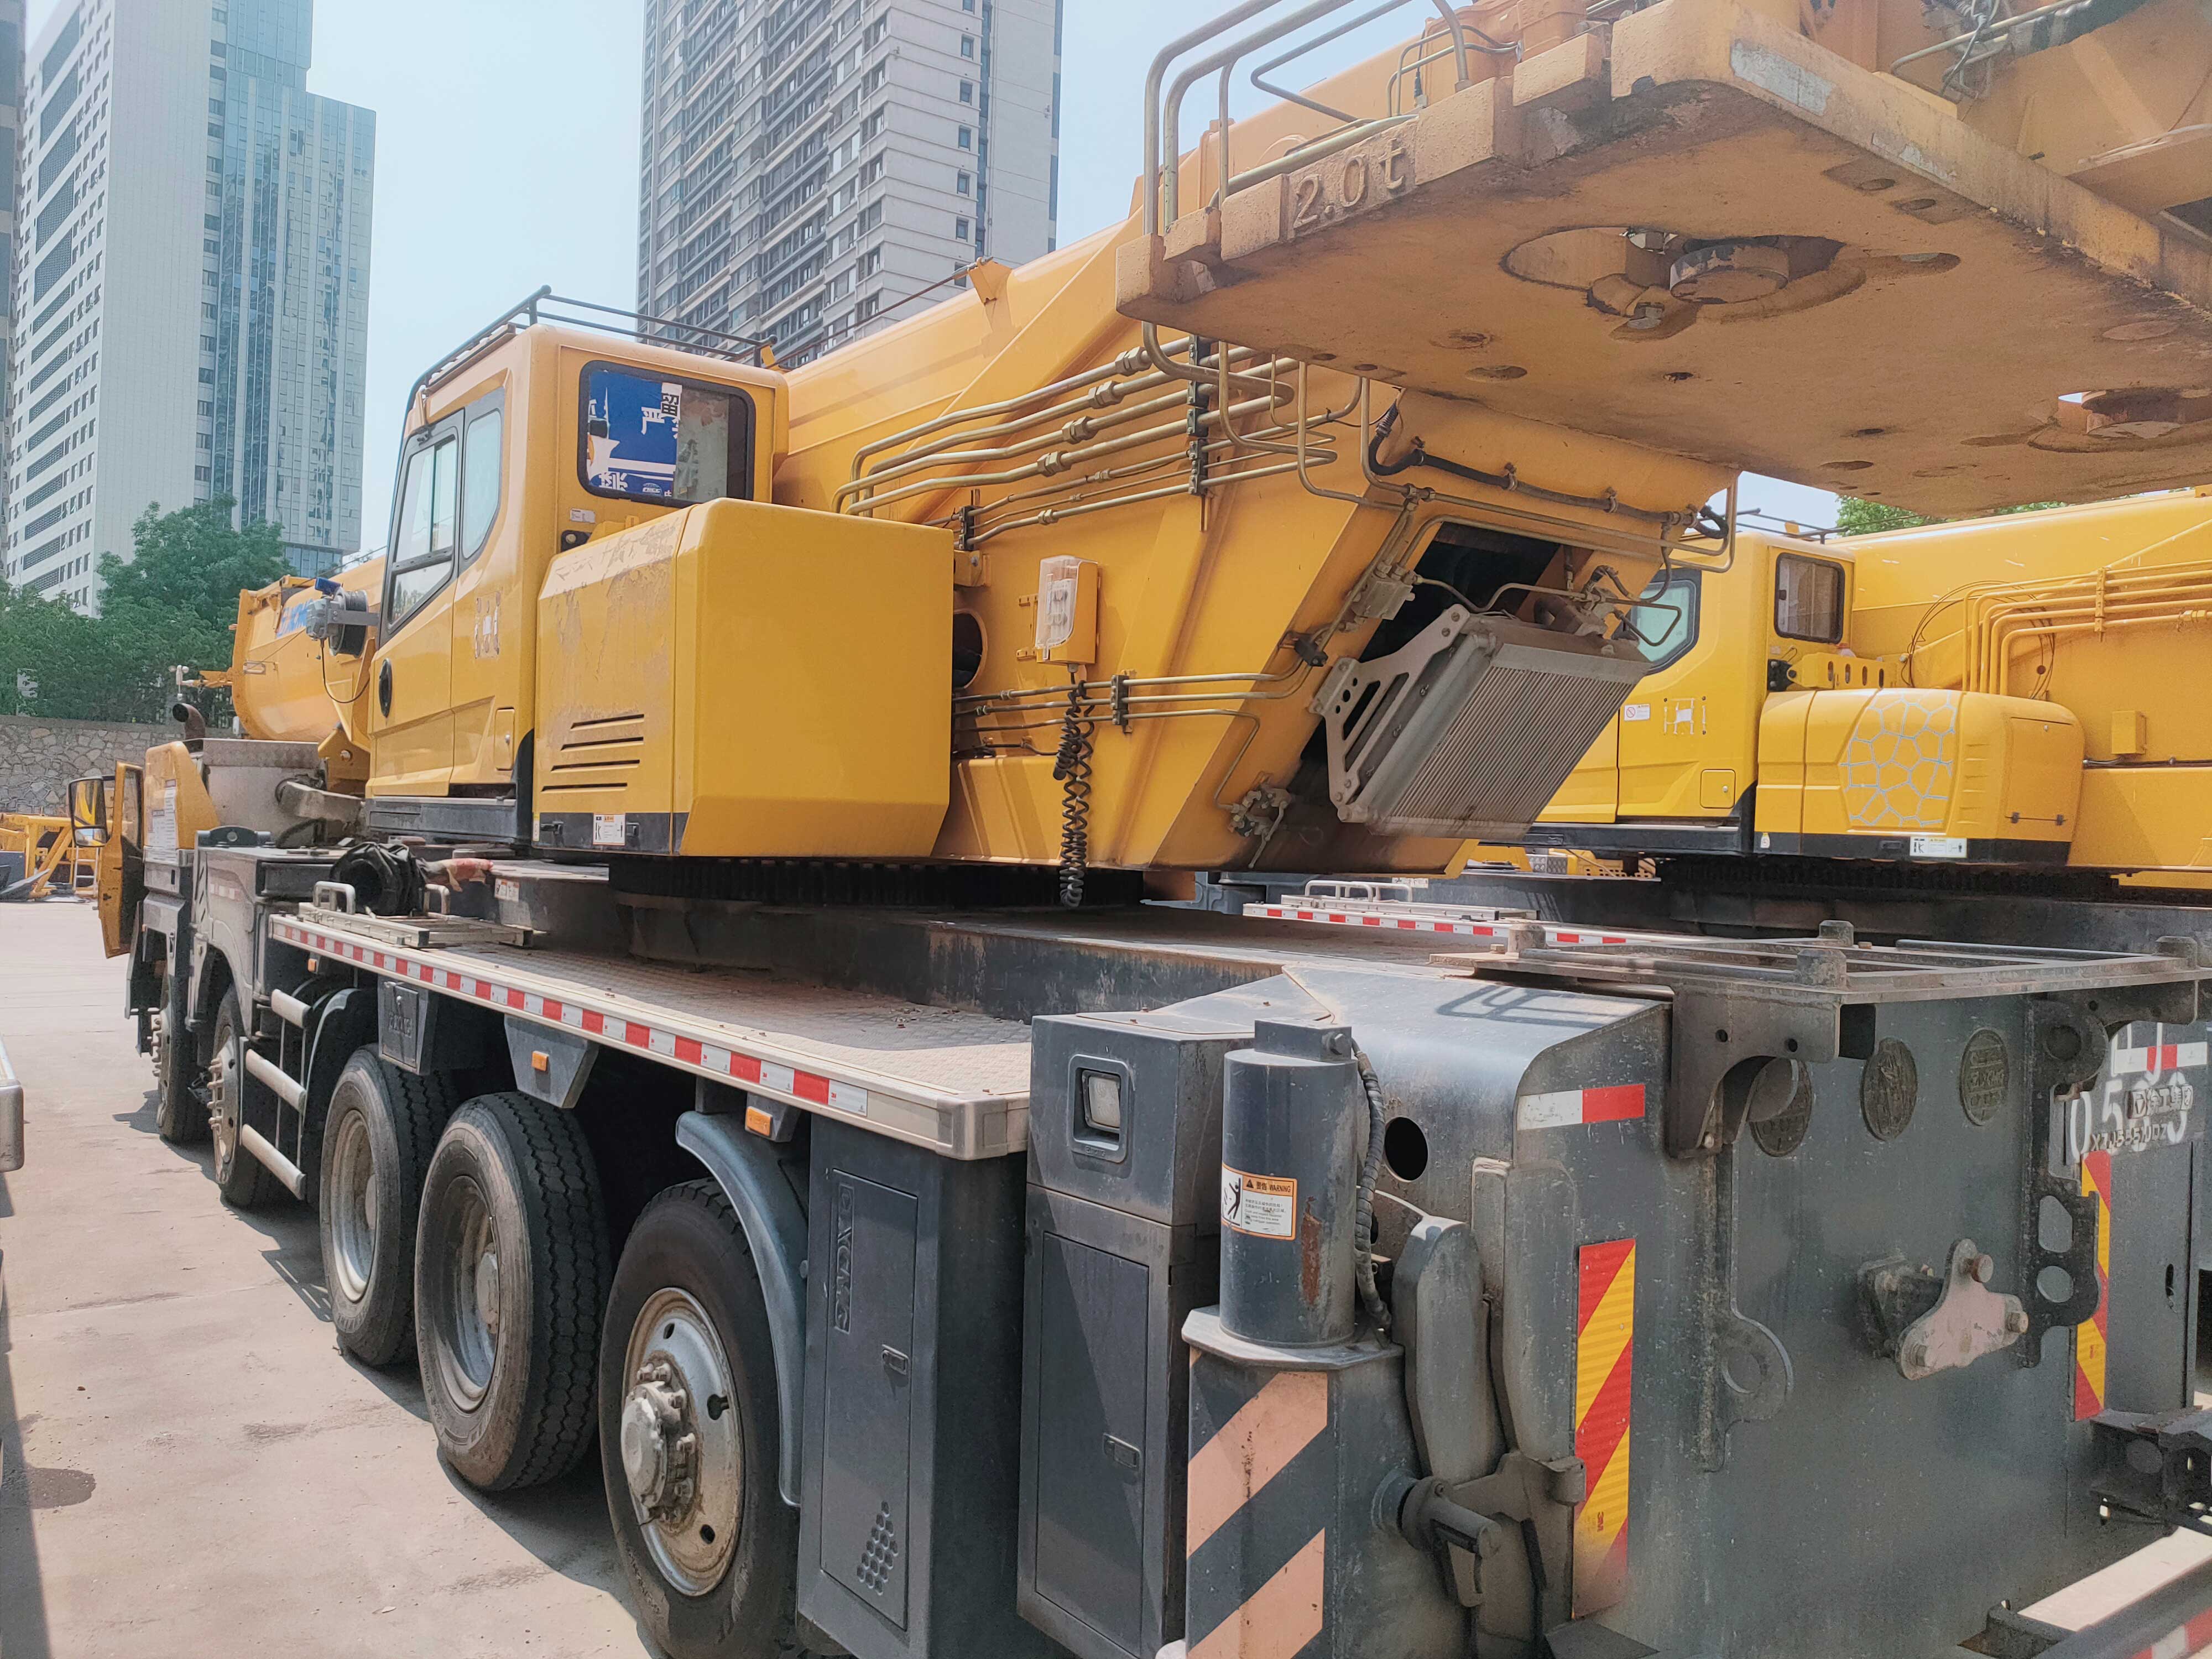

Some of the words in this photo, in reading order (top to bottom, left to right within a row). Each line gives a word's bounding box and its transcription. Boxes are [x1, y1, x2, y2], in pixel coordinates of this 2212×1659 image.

[1293, 137, 1407, 230] 2.0t
[661, 393, 680, 417] 留
[1256, 1181, 1267, 1190] 警告
[1269, 1184, 1291, 1193] WARNING
[1597, 1511, 1604, 1532] 3M
